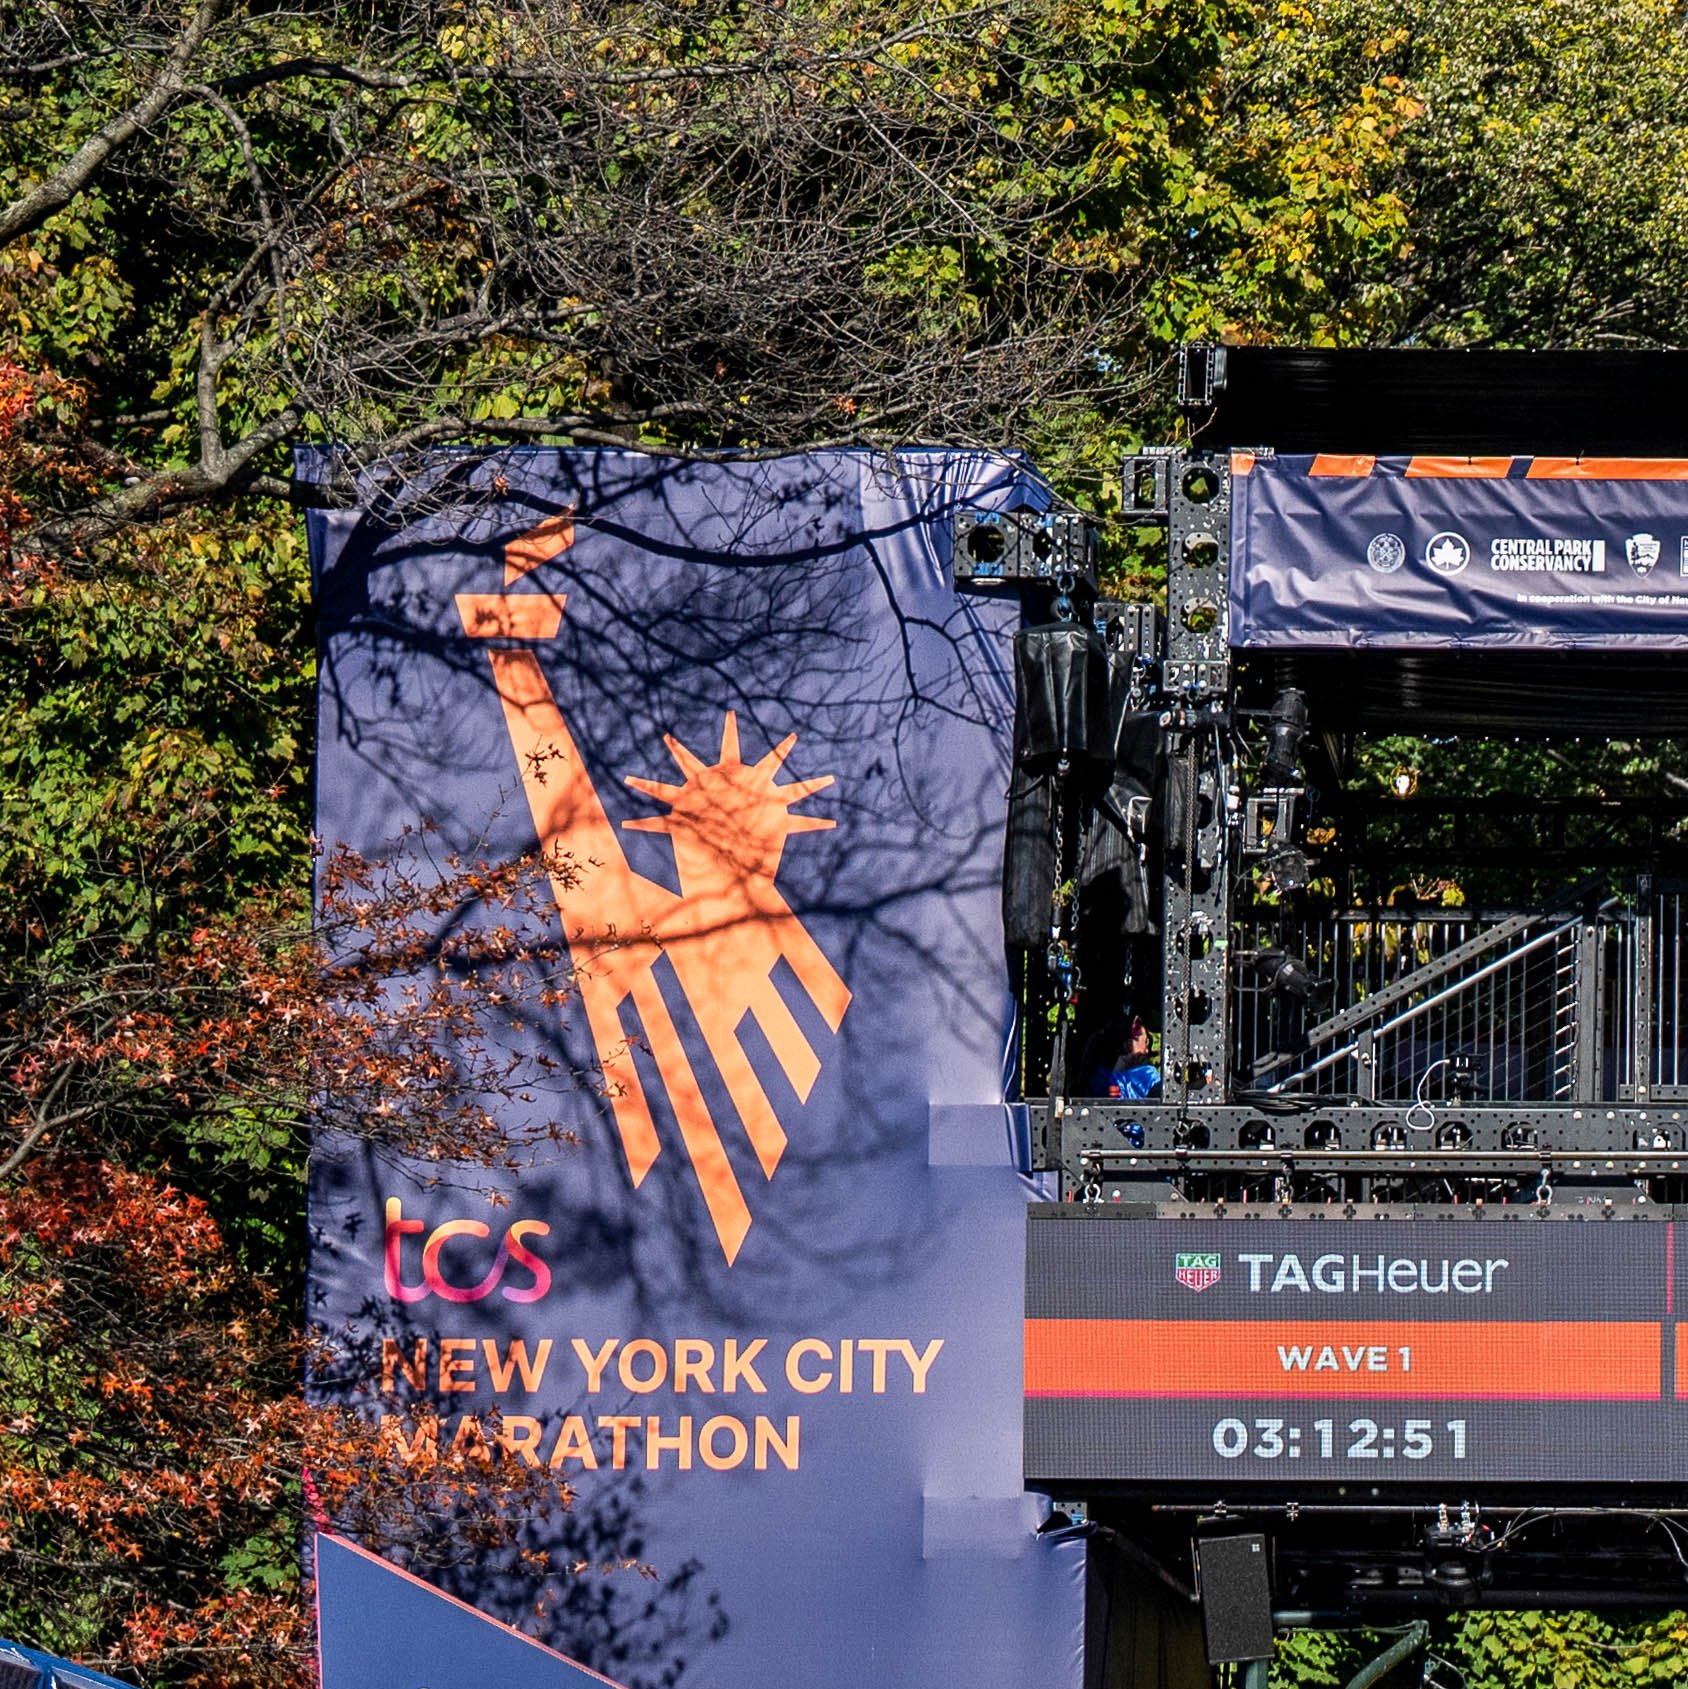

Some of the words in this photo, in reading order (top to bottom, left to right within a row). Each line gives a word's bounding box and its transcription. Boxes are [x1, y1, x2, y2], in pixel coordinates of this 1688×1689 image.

[1491, 538, 1551, 555] CENTRAL
[1553, 539, 1592, 556] PARK
[1491, 555, 1592, 571] CONSERVANCY
[1592, 592, 1614, 603] with
[1616, 592, 1633, 604] the
[1635, 593, 1657, 607] City
[1658, 593, 1670, 604] of
[384, 1196, 552, 1303] tcs
[1178, 1255, 1221, 1268] TAG
[1176, 1268, 1221, 1286] HEUER
[381, 1339, 554, 1393] NEW
[572, 1339, 768, 1393] YORK
[784, 1338, 945, 1394] CITY
[1277, 1346, 1388, 1371] WAVE
[1399, 1346, 1412, 1371] 1
[381, 1415, 801, 1470] MARATHON
[1211, 1418, 1469, 1459] 03:12:51
